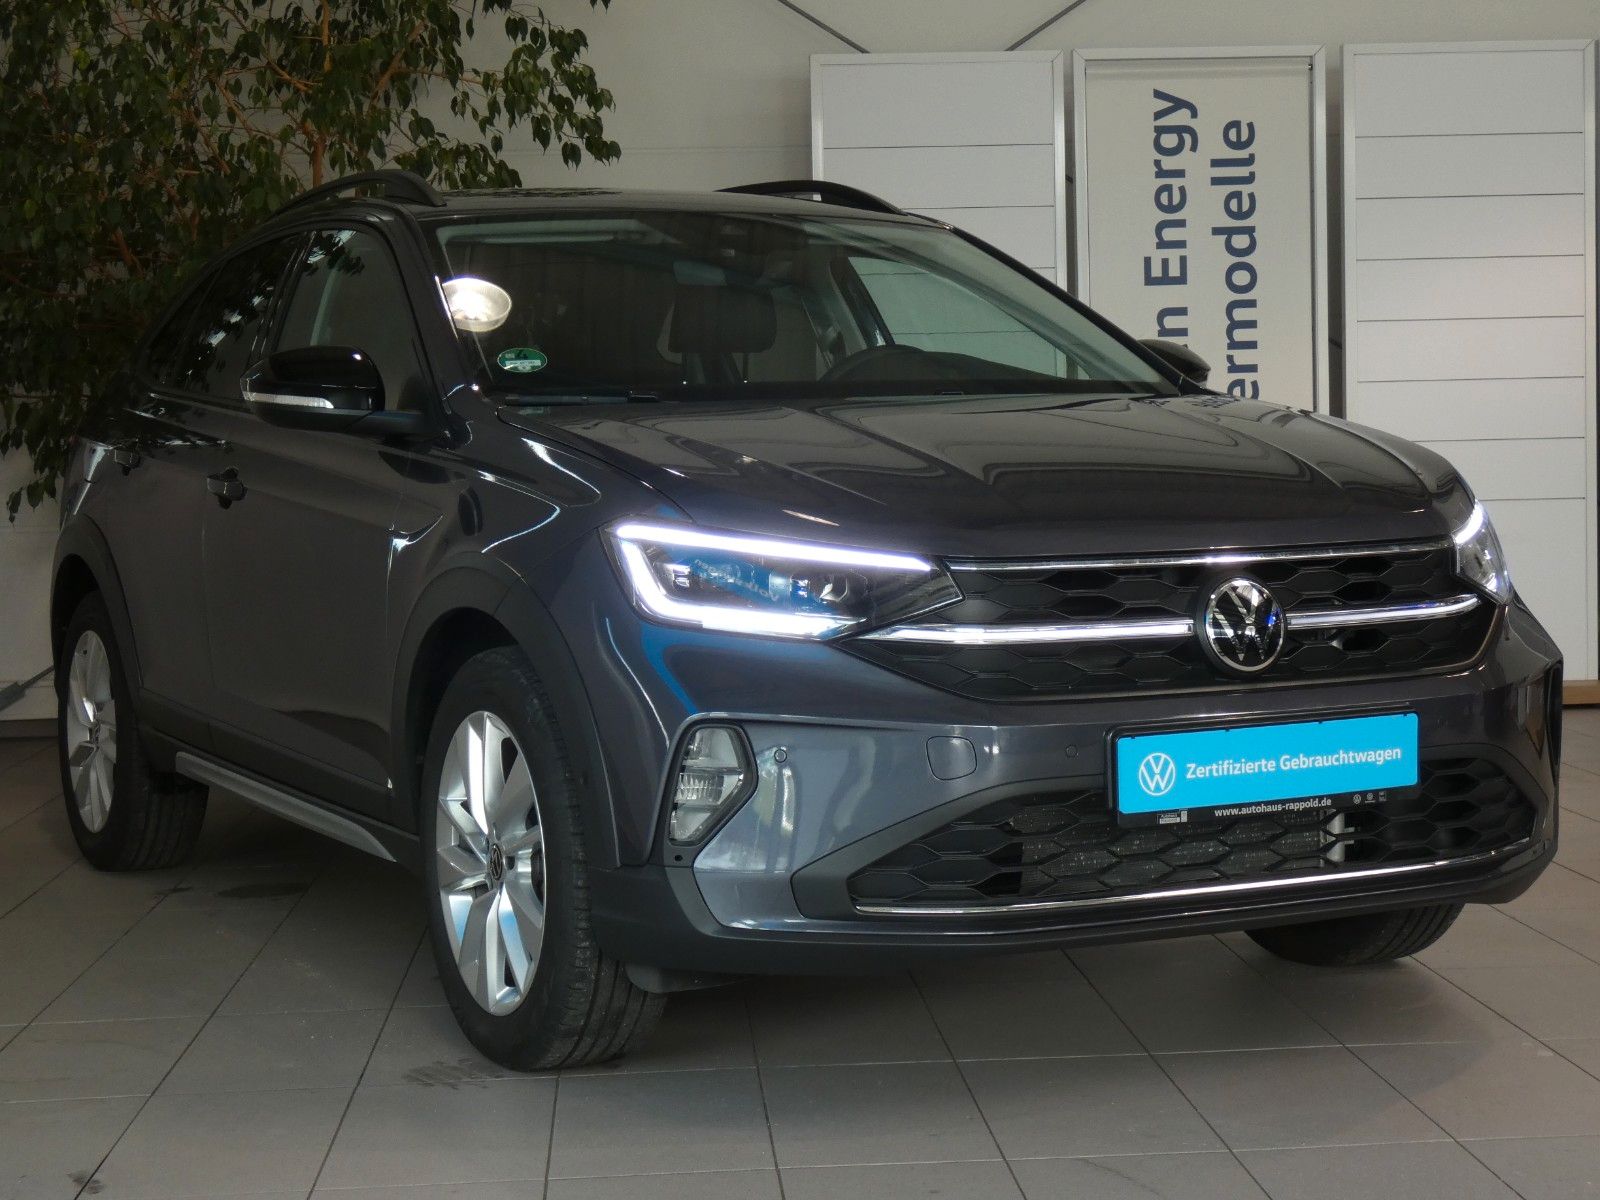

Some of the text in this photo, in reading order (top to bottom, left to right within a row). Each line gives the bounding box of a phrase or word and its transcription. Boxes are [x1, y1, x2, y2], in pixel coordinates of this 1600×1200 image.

[1143, 87, 1199, 287] Energy
[1210, 119, 1260, 400] ermodelle
[1186, 747, 1402, 779] Zertifizierte Gebrauchtwagen
[1214, 797, 1332, 817] www.autohaus-rappold.de
